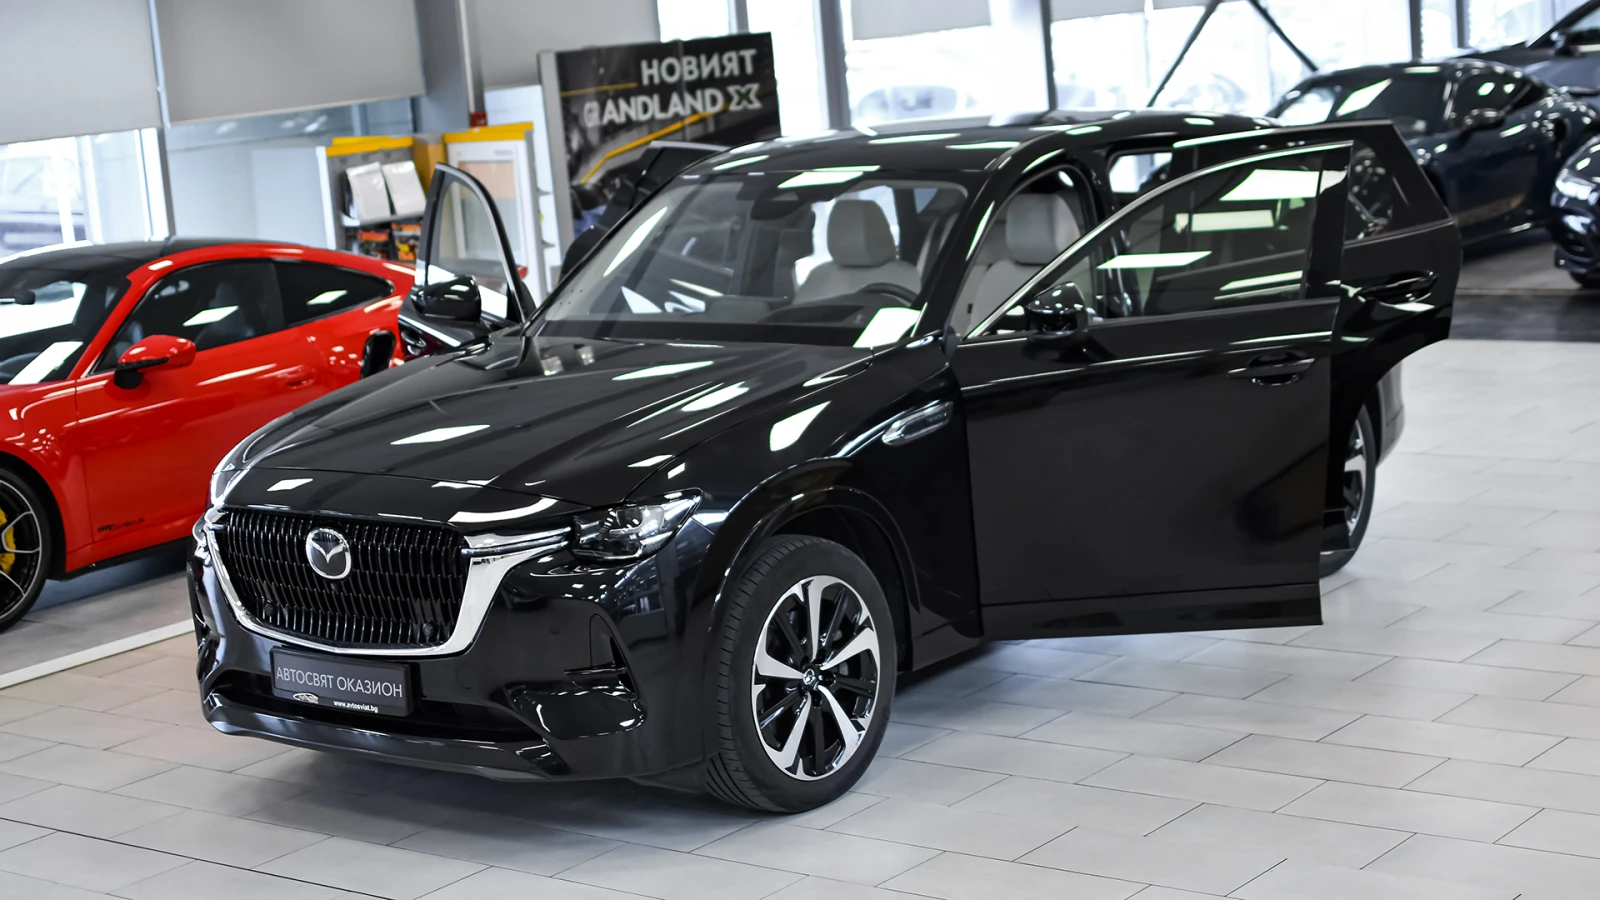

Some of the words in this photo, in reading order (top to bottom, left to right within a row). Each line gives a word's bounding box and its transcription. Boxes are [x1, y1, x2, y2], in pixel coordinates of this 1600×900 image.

[640, 49, 757, 86] НОВИЯТ
[276, 667, 334, 689] АВТОСВЯТ
[336, 676, 403, 698] ОКАЗИОН
